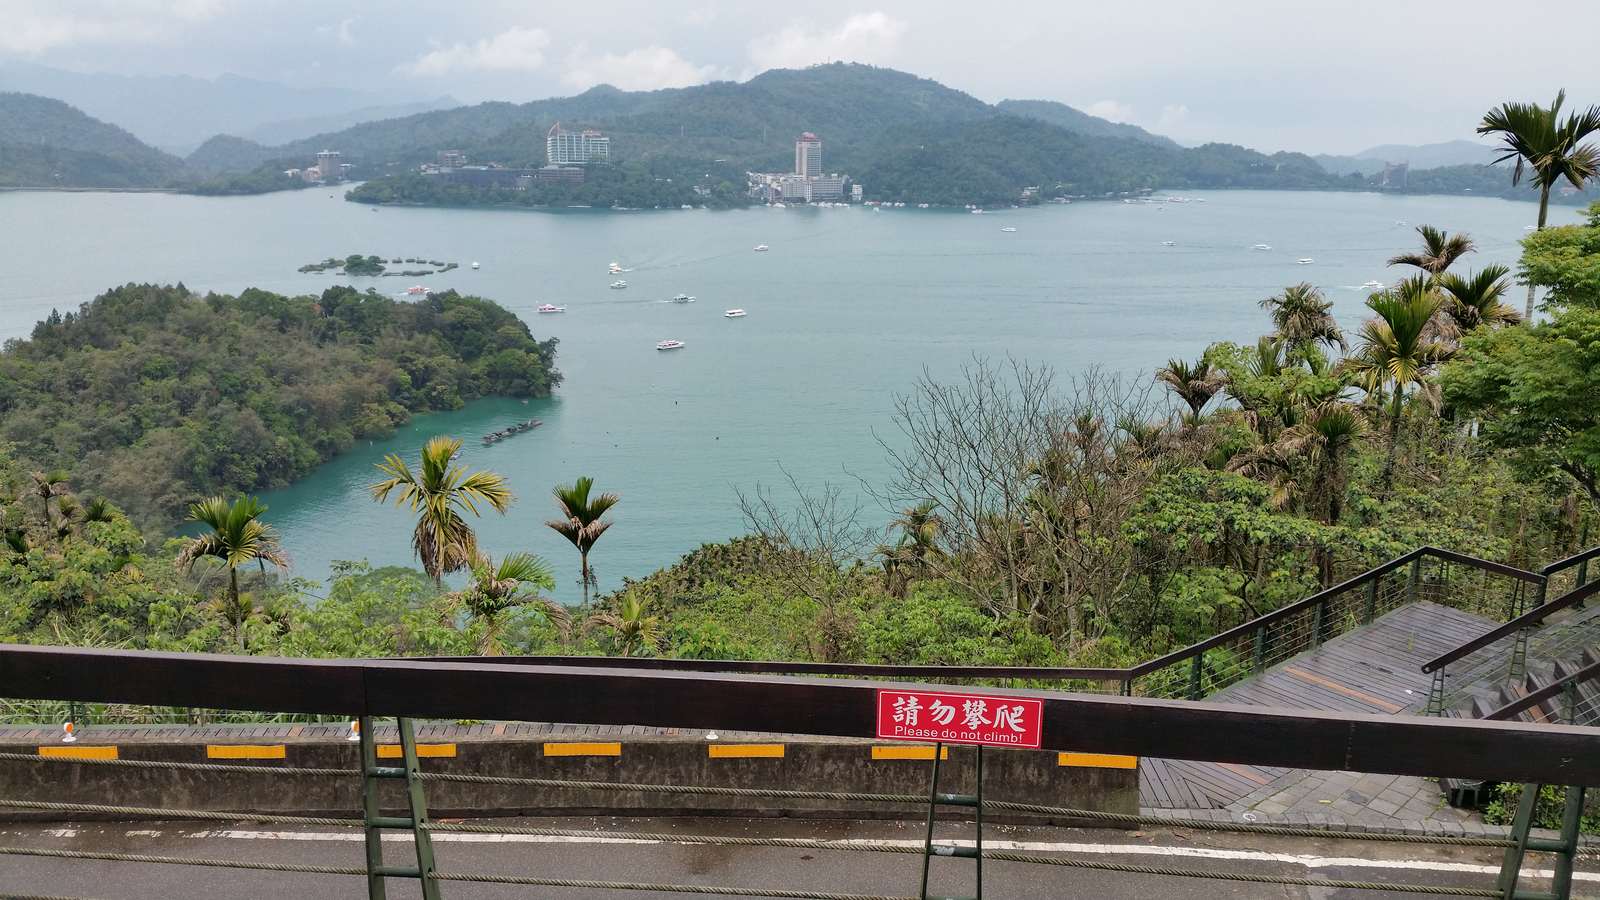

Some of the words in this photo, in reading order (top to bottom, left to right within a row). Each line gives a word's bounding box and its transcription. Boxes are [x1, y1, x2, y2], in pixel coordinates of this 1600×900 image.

[892, 695, 1026, 732] 請勿攀爬
[895, 726, 938, 738] Please
[941, 728, 957, 739] do
[960, 730, 980, 740] not
[984, 731, 1023, 744] climb!
